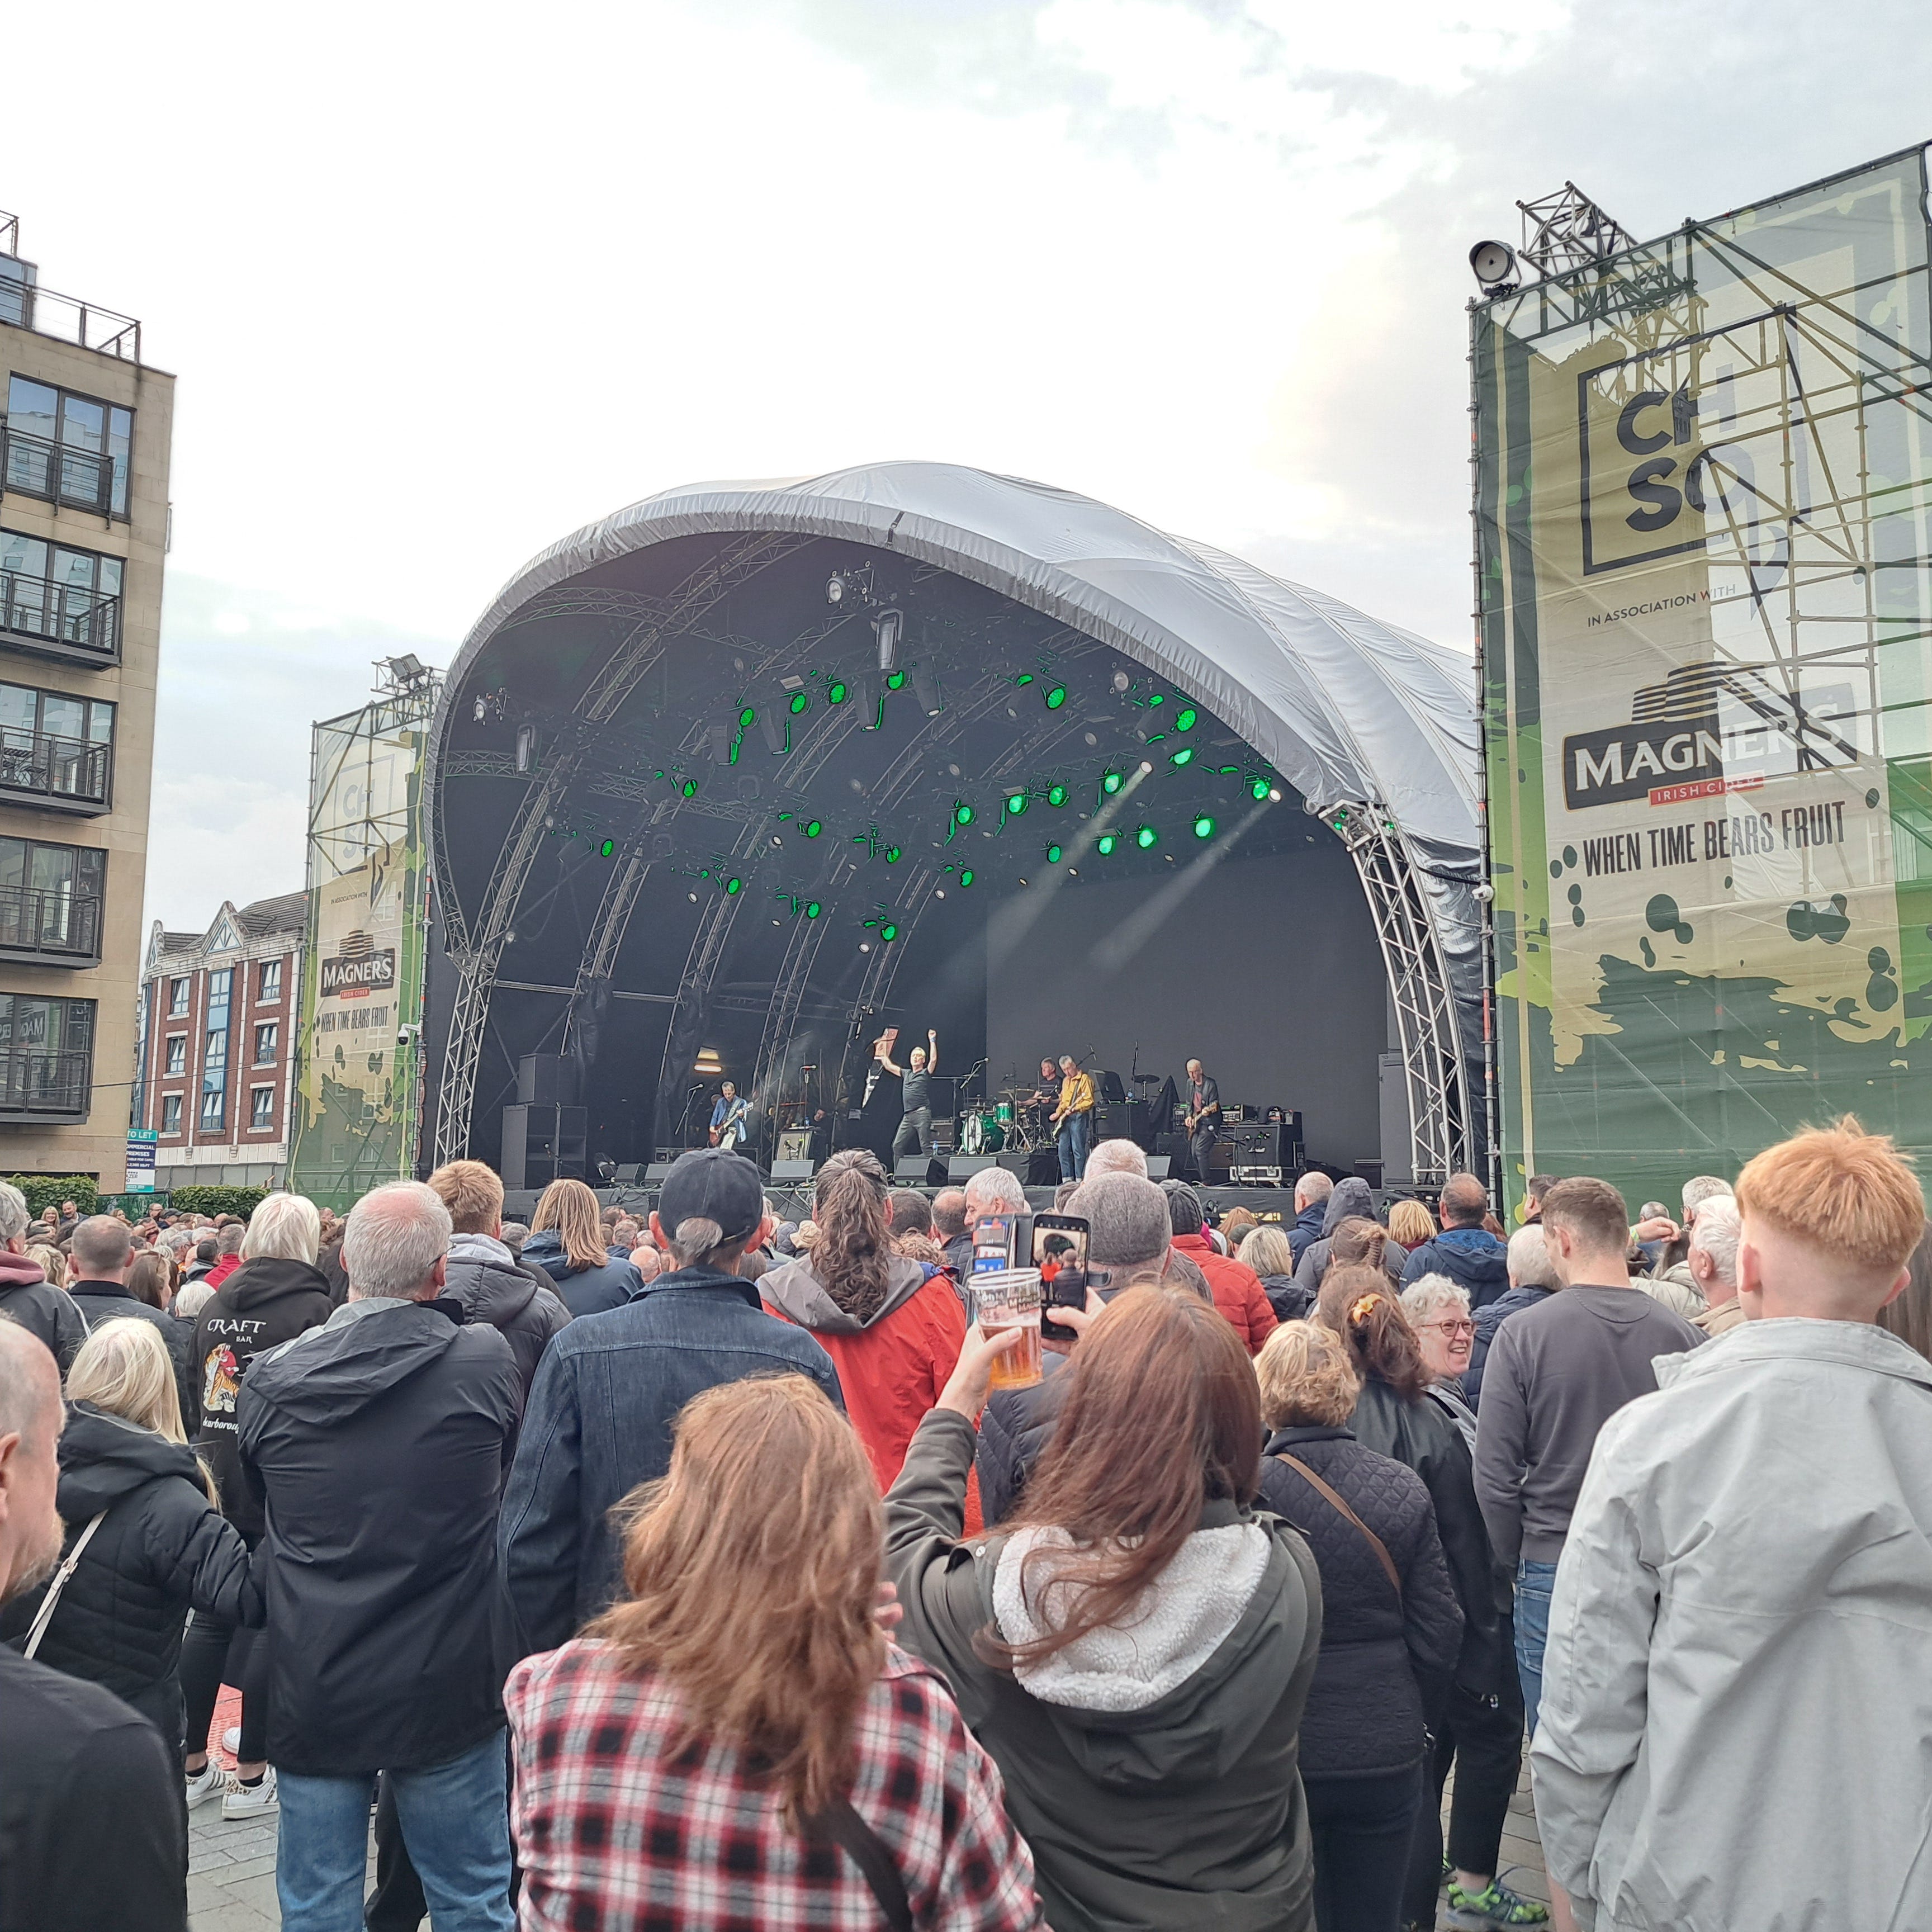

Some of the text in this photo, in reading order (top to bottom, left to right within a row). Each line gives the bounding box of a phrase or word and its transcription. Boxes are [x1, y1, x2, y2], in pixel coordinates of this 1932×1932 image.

[1587, 584, 1736, 628] IN ASSOCIATION WITH
[1657, 785, 1699, 802] IRISH
[1583, 801, 1845, 877] WHEN TIME BEARS FRUIT
[323, 957, 391, 988] MAGNERS
[321, 1006, 389, 1033] WHEN TIME BEARS FRUIT
[207, 1319, 267, 1334] CRAFT
[236, 1336, 253, 1344] BAR
